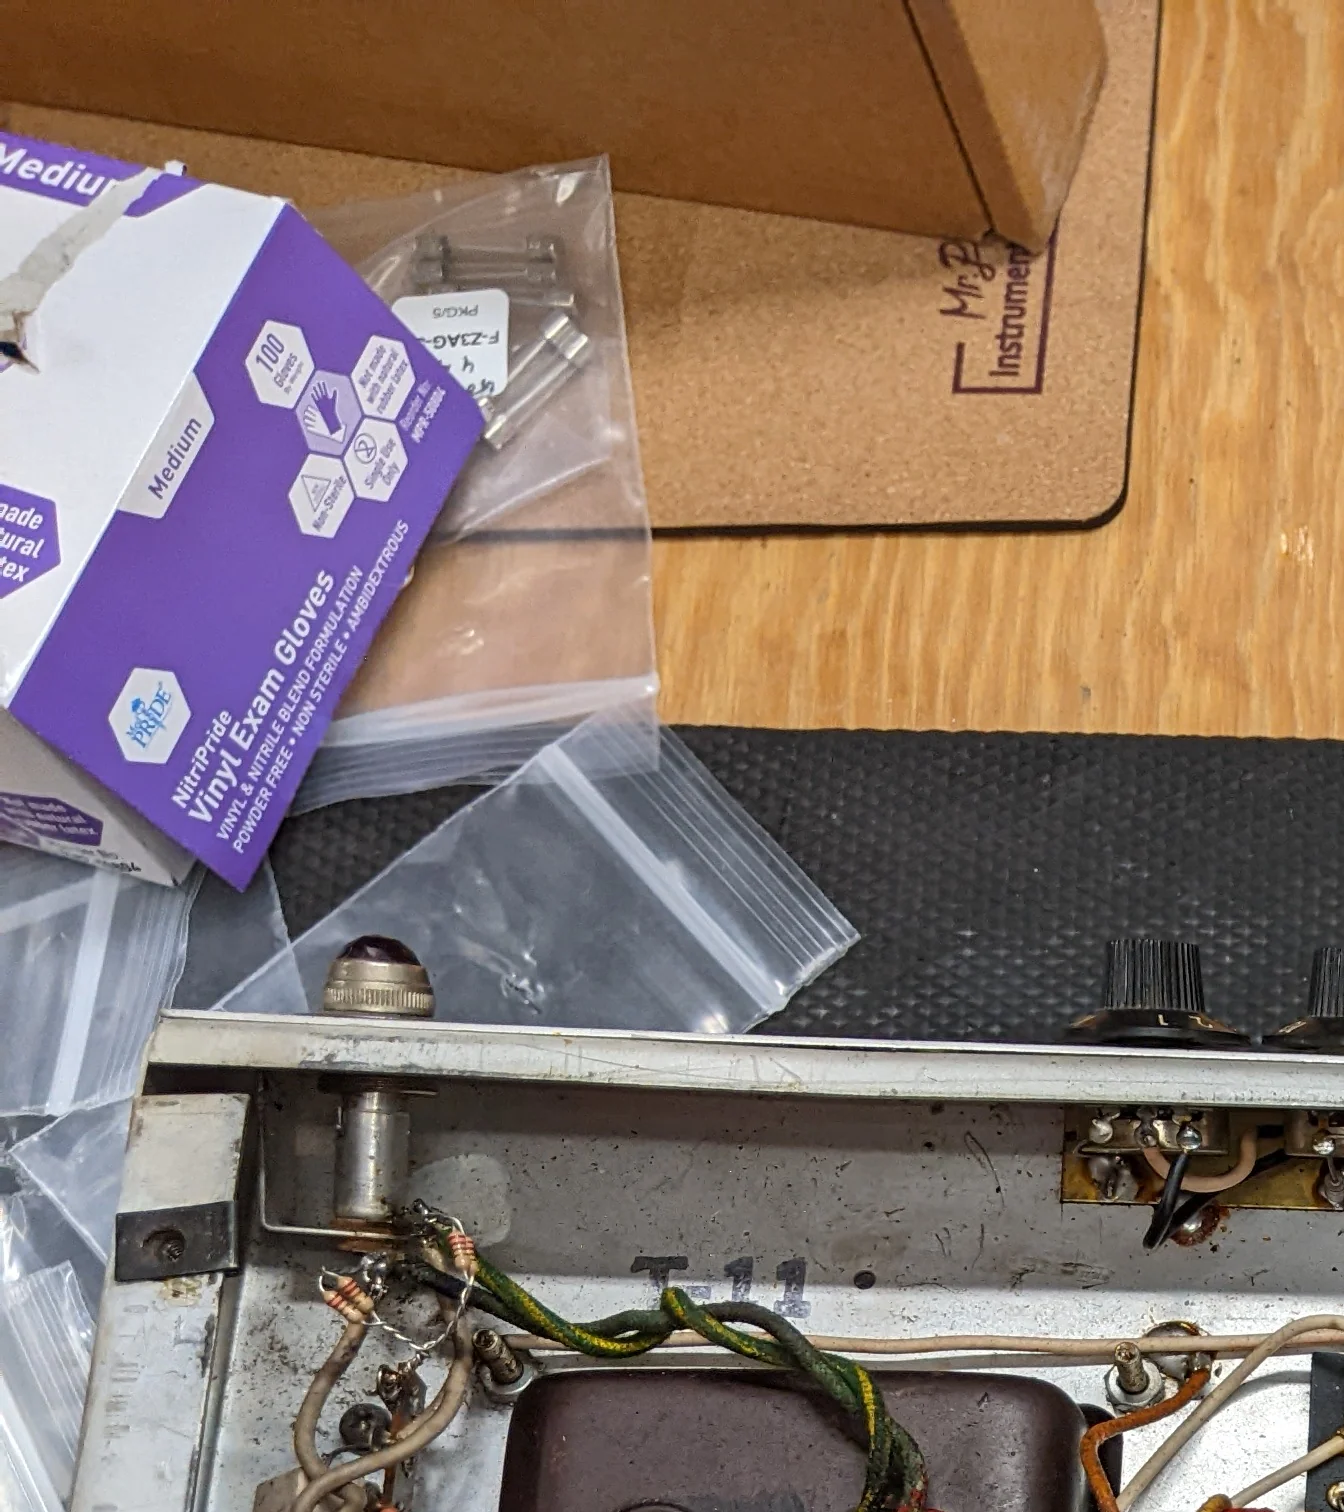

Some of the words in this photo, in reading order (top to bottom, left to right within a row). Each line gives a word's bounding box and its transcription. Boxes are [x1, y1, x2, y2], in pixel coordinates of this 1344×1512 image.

[0, 142, 120, 197] Mediu
[256, 334, 284, 372] 100
[148, 419, 201, 499] Medium
[188, 749, 241, 822] Vinyl
[229, 669, 284, 750] Exam
[275, 570, 333, 665] Gloves
[216, 799, 247, 839] VINYL
[240, 783, 254, 796] &
[248, 720, 284, 781] NITRILE
[278, 670, 310, 722] BLEND
[305, 565, 362, 671] FORMULATION
[233, 787, 272, 853] POWDER
[266, 746, 293, 788] FREE
[292, 700, 316, 736] NON
[310, 639, 347, 702] STERILE
[347, 520, 408, 631] AMBIDEXTROUS
[172, 711, 231, 808] NitriPride
